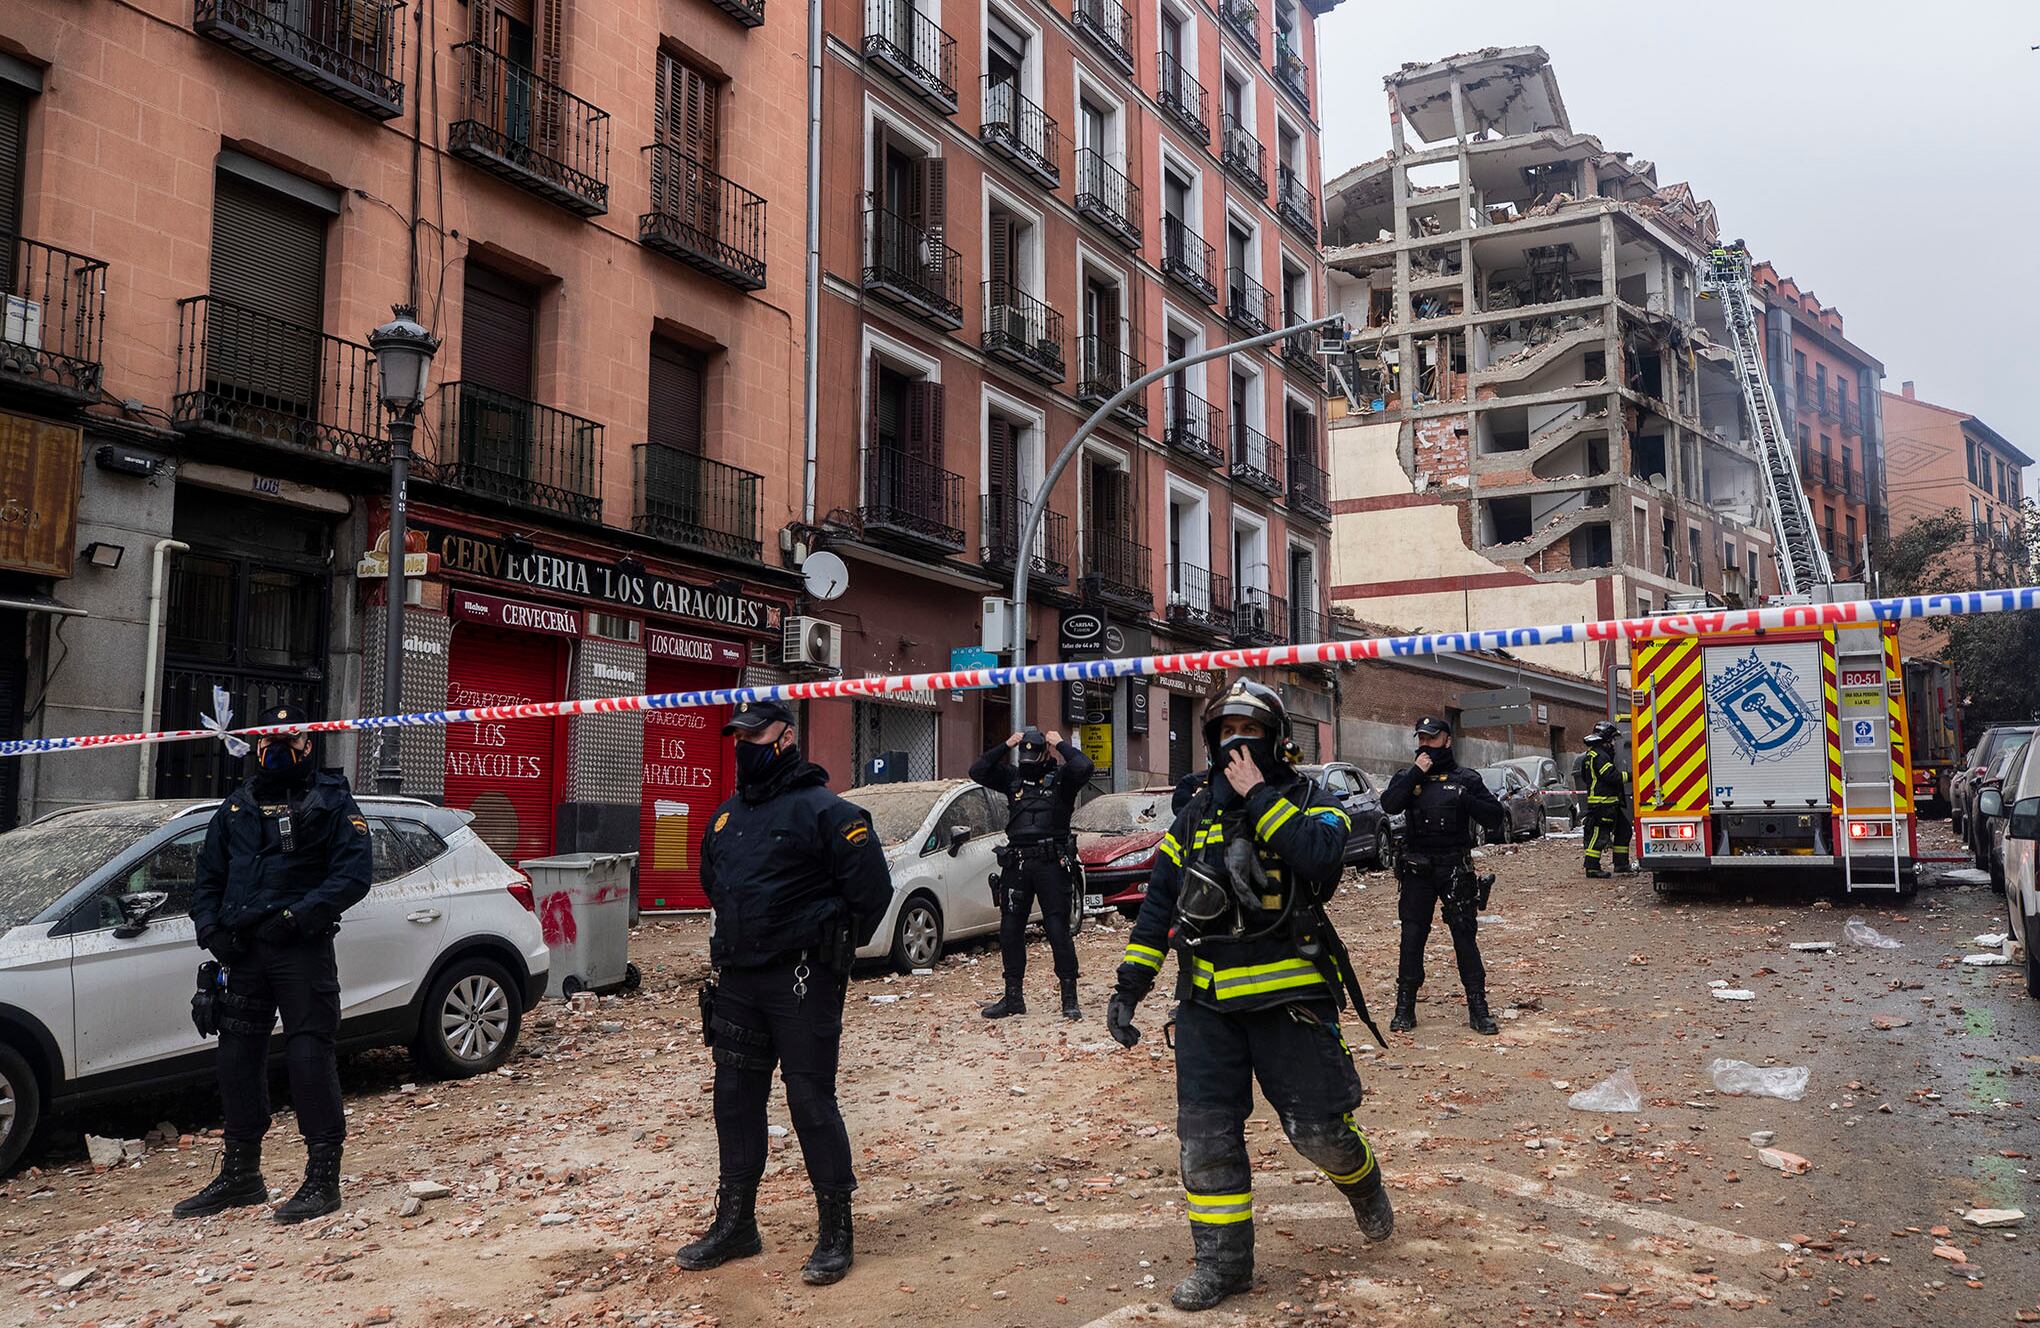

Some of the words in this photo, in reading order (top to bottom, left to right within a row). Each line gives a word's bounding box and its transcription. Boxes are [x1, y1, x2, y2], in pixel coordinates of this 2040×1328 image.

[256, 476, 278, 493] 106
[441, 535, 590, 594] CERVECERIA
[464, 601, 488, 613] Mahou
[502, 604, 578, 634] CERVECERÍA
[1783, 603, 1857, 627] NO
[402, 635, 441, 654] ahou
[652, 635, 668, 654] LOS
[669, 637, 712, 661] CARACOLES
[1317, 640, 1379, 662] NO
[593, 662, 635, 682] Mahou
[643, 709, 707, 729] erveceria
[473, 722, 506, 747] LOS
[660, 738, 685, 759] LOS
[444, 751, 541, 778] ARACOLES
[874, 759, 885, 774] P
[641, 763, 712, 788] ARACOLES
[1715, 786, 1734, 797] PT
[1652, 843, 1678, 853] 2214
[1682, 843, 1702, 852] JKX
[1085, 895, 1101, 905] BLS
